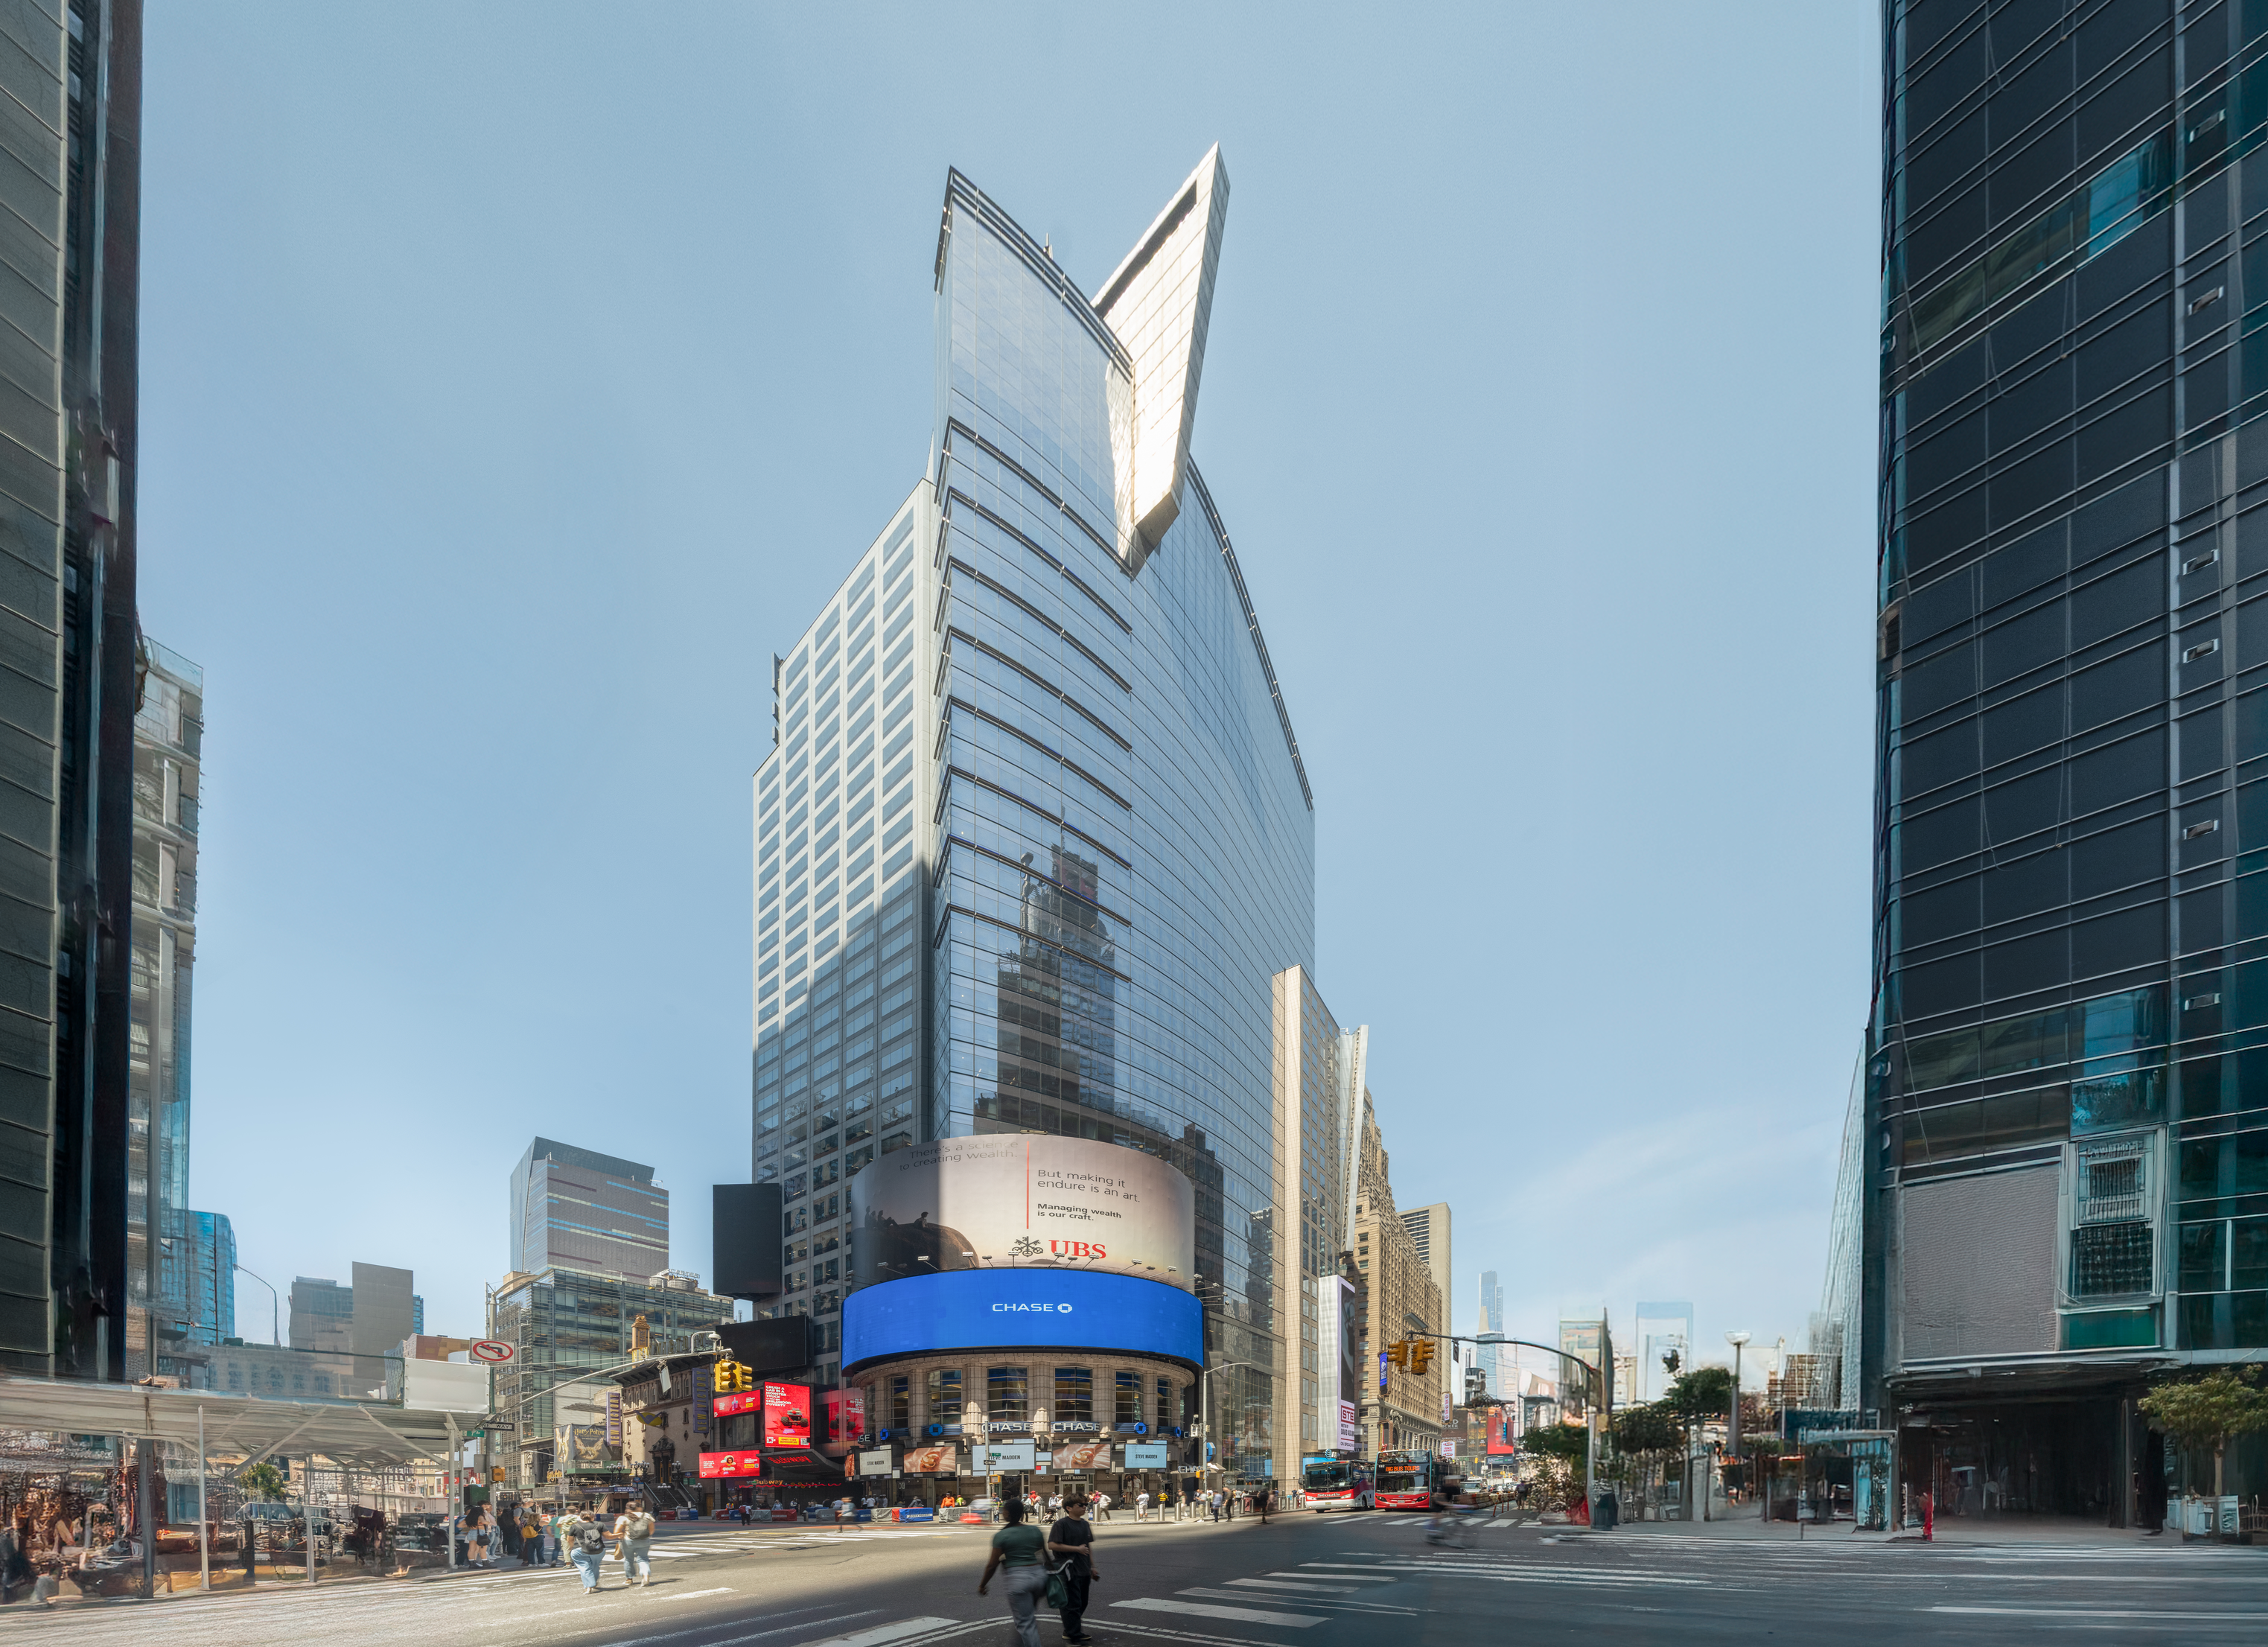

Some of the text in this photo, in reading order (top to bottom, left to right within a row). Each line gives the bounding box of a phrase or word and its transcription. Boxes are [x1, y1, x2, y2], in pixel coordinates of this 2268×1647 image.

[909, 1145, 951, 1159] There's
[969, 1140, 1019, 1149] science
[914, 1154, 961, 1167] creating
[966, 1150, 1018, 1159] wealth.
[1038, 1170, 1125, 1188] But making it
[1037, 1180, 1140, 1202] endure is an art.
[1037, 1203, 1121, 1218] Managing wealth
[1048, 1240, 1106, 1259] UBS
[992, 1303, 1054, 1312] CHASE
[697, 1371, 707, 1431] NEW VICTORY
[610, 1394, 619, 1444] NEW VICTORY
[1053, 1422, 1100, 1431] CHASE
